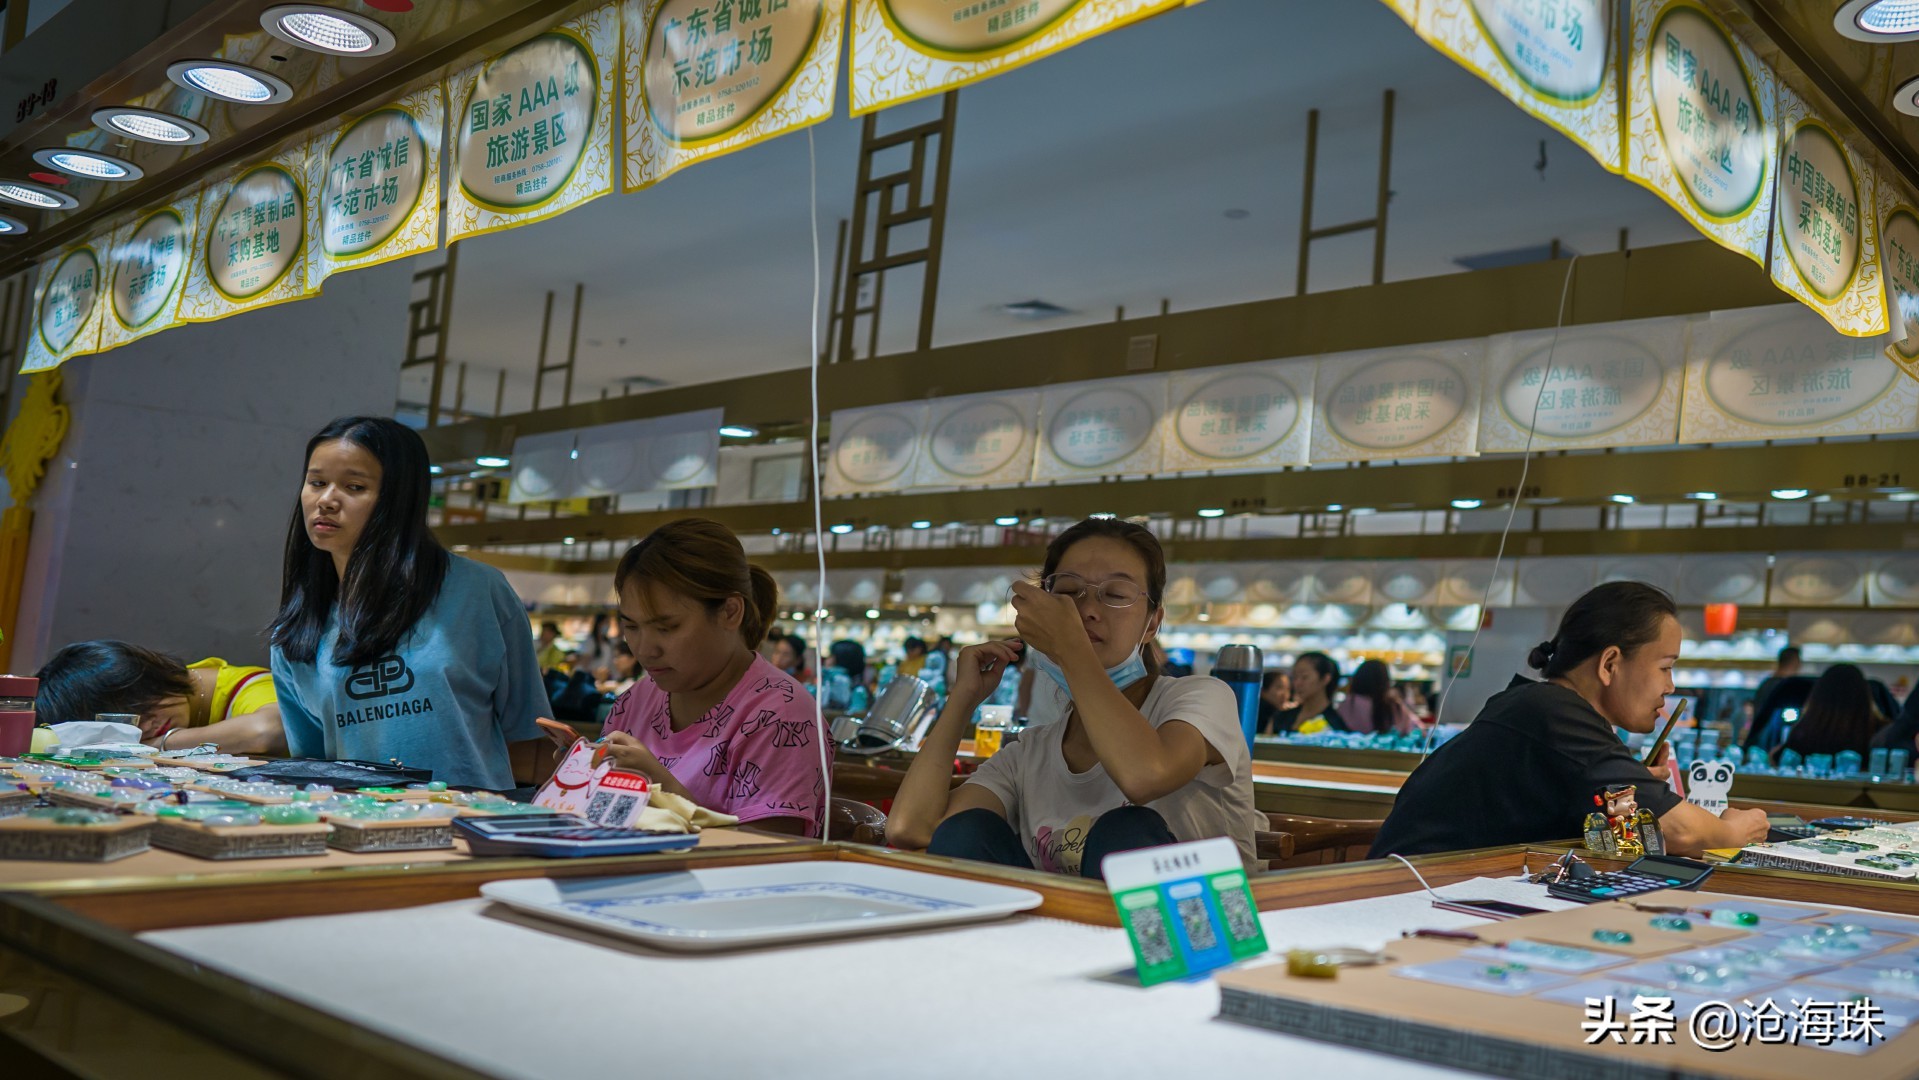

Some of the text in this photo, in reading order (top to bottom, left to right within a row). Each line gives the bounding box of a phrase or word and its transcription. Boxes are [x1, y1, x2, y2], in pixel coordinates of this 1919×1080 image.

[672, 25, 773, 96] 示范市场
[1666, 31, 1749, 135] 国家 AAA 级
[470, 60, 580, 135] 国家 AAA 级
[696, 102, 736, 126] 精品挂件
[328, 136, 410, 193] 广东省诚信
[486, 112, 567, 168] 旅游景区
[332, 176, 399, 222] 示范市场
[516, 176, 548, 196] 精品挂件
[1788, 151, 1857, 237] 中国翡翠制品
[227, 227, 280, 267] 采购基地
[342, 230, 372, 246] 精品挂件
[1798, 199, 1842, 265] 采购基地
[336, 698, 433, 728] BALENCIAGA
